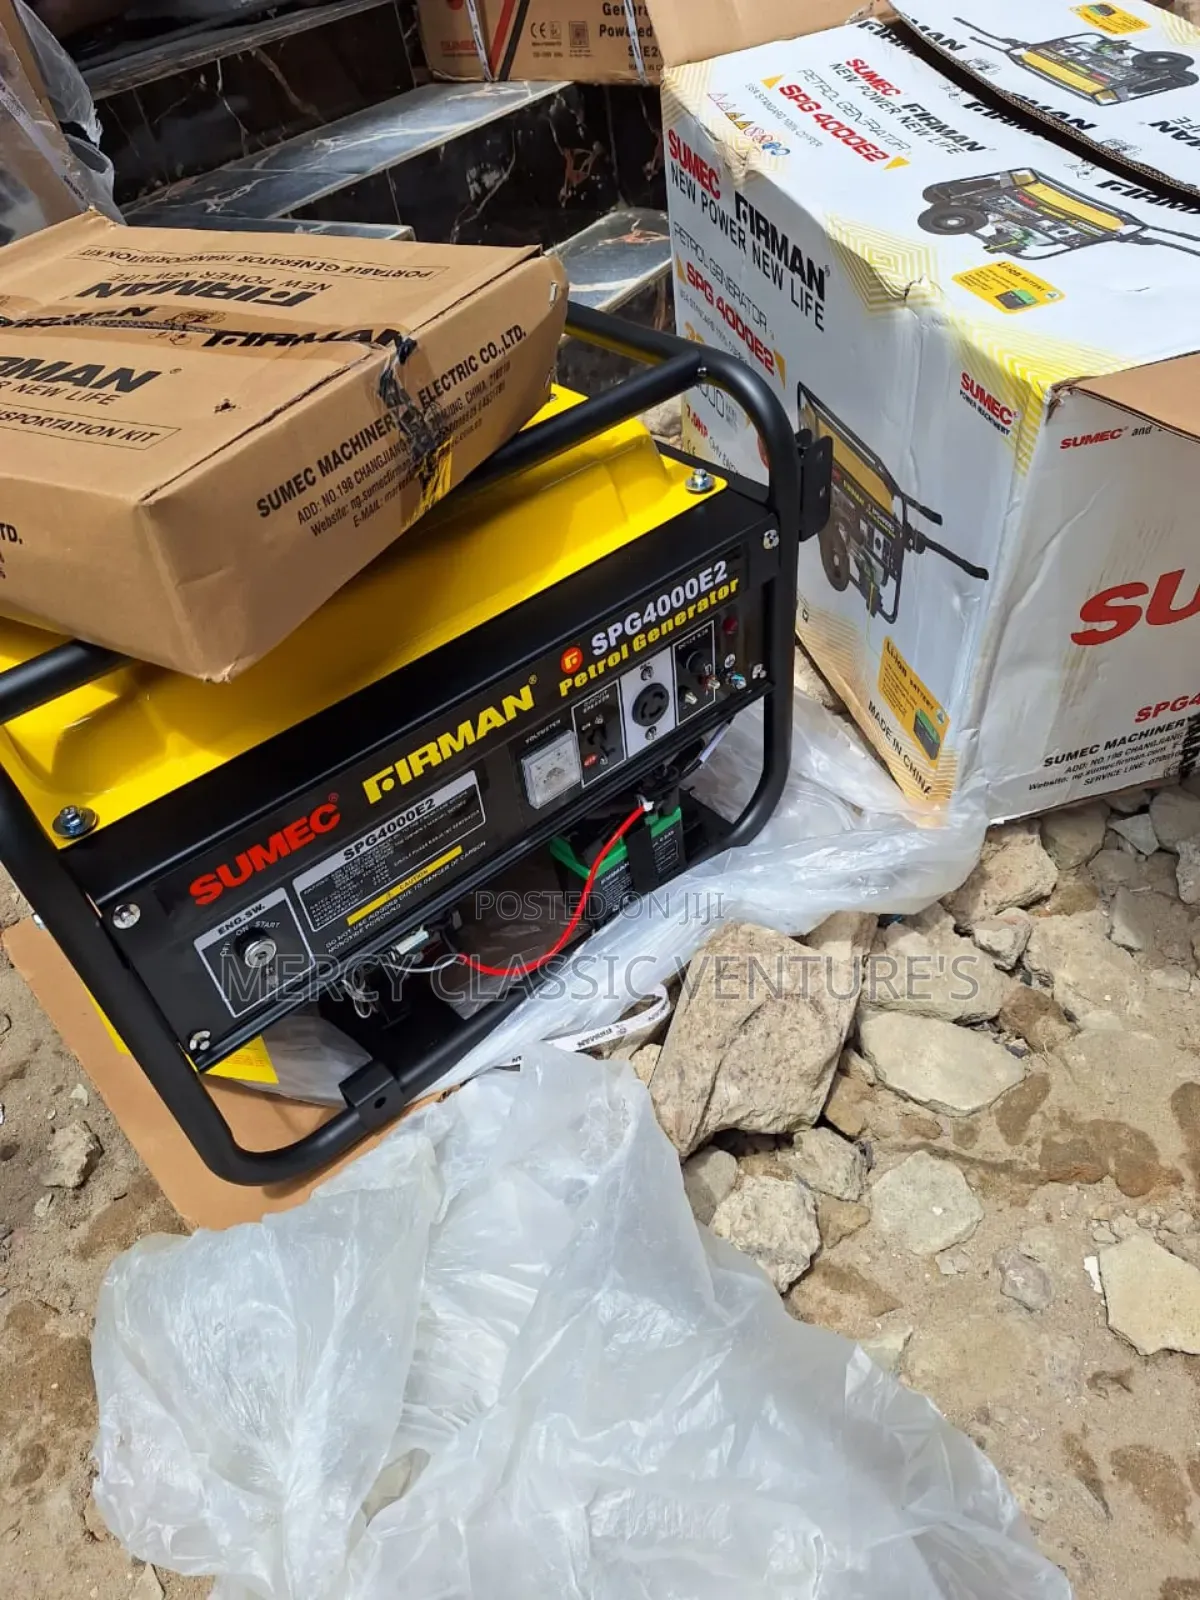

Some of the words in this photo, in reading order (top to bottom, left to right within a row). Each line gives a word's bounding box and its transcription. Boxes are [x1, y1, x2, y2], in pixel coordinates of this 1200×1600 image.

[829, 63, 862, 87] NEW
[857, 84, 903, 116] POWER
[900, 115, 931, 140] NEW
[928, 134, 968, 155] LIFE
[846, 58, 901, 97] SUMEC
[901, 102, 987, 152] FIRMAN
[779, 84, 823, 113] SPG
[813, 113, 890, 163] 4000E2
[668, 128, 720, 200] SUMEC
[735, 191, 826, 302] FIRMAN
[79, 249, 102, 257] KIT
[107, 250, 235, 265] TRANSPORTATION
[238, 255, 342, 273] GENERATOR
[671, 164, 696, 205] NEW
[701, 192, 747, 253] POWER
[752, 241, 784, 291] NEW
[790, 282, 825, 332] LIFE
[108, 273, 151, 283] LIFE
[156, 271, 196, 281] NEW
[199, 271, 276, 285] POWER
[279, 280, 332, 291] NEW
[344, 263, 432, 280] PORTABLE
[673, 221, 710, 270] PETROL
[709, 264, 768, 333] GENERATOR
[76, 280, 316, 307] FIRMAN
[687, 261, 714, 305] SPG
[716, 295, 775, 375] 4000E2
[11, 383, 68, 398] NEW
[66, 390, 121, 406] LIFE
[961, 371, 1013, 425] SUMEC
[119, 430, 161, 443] KIT
[256, 468, 317, 518] SUMEC
[418, 355, 479, 410] ELECTRIC
[479, 324, 527, 365] CO.,LTD.
[1060, 427, 1124, 449] SUMEC
[297, 501, 323, 526] ADD:
[310, 504, 350, 537] Website:
[590, 560, 728, 657] SPG4000E2
[559, 645, 630, 697] Petrol
[633, 577, 739, 653] Generator
[868, 700, 893, 741] MADE
[892, 738, 903, 757] IN
[903, 754, 933, 796] CHINA
[1043, 744, 1101, 767] SUMEC
[189, 802, 341, 905] SUMEC
[361, 685, 536, 805] FIRMAN
[344, 798, 437, 861] SPG4000E2
[218, 903, 266, 936] ENG.SW.
[235, 924, 249, 937] ON
[254, 920, 281, 929] START
